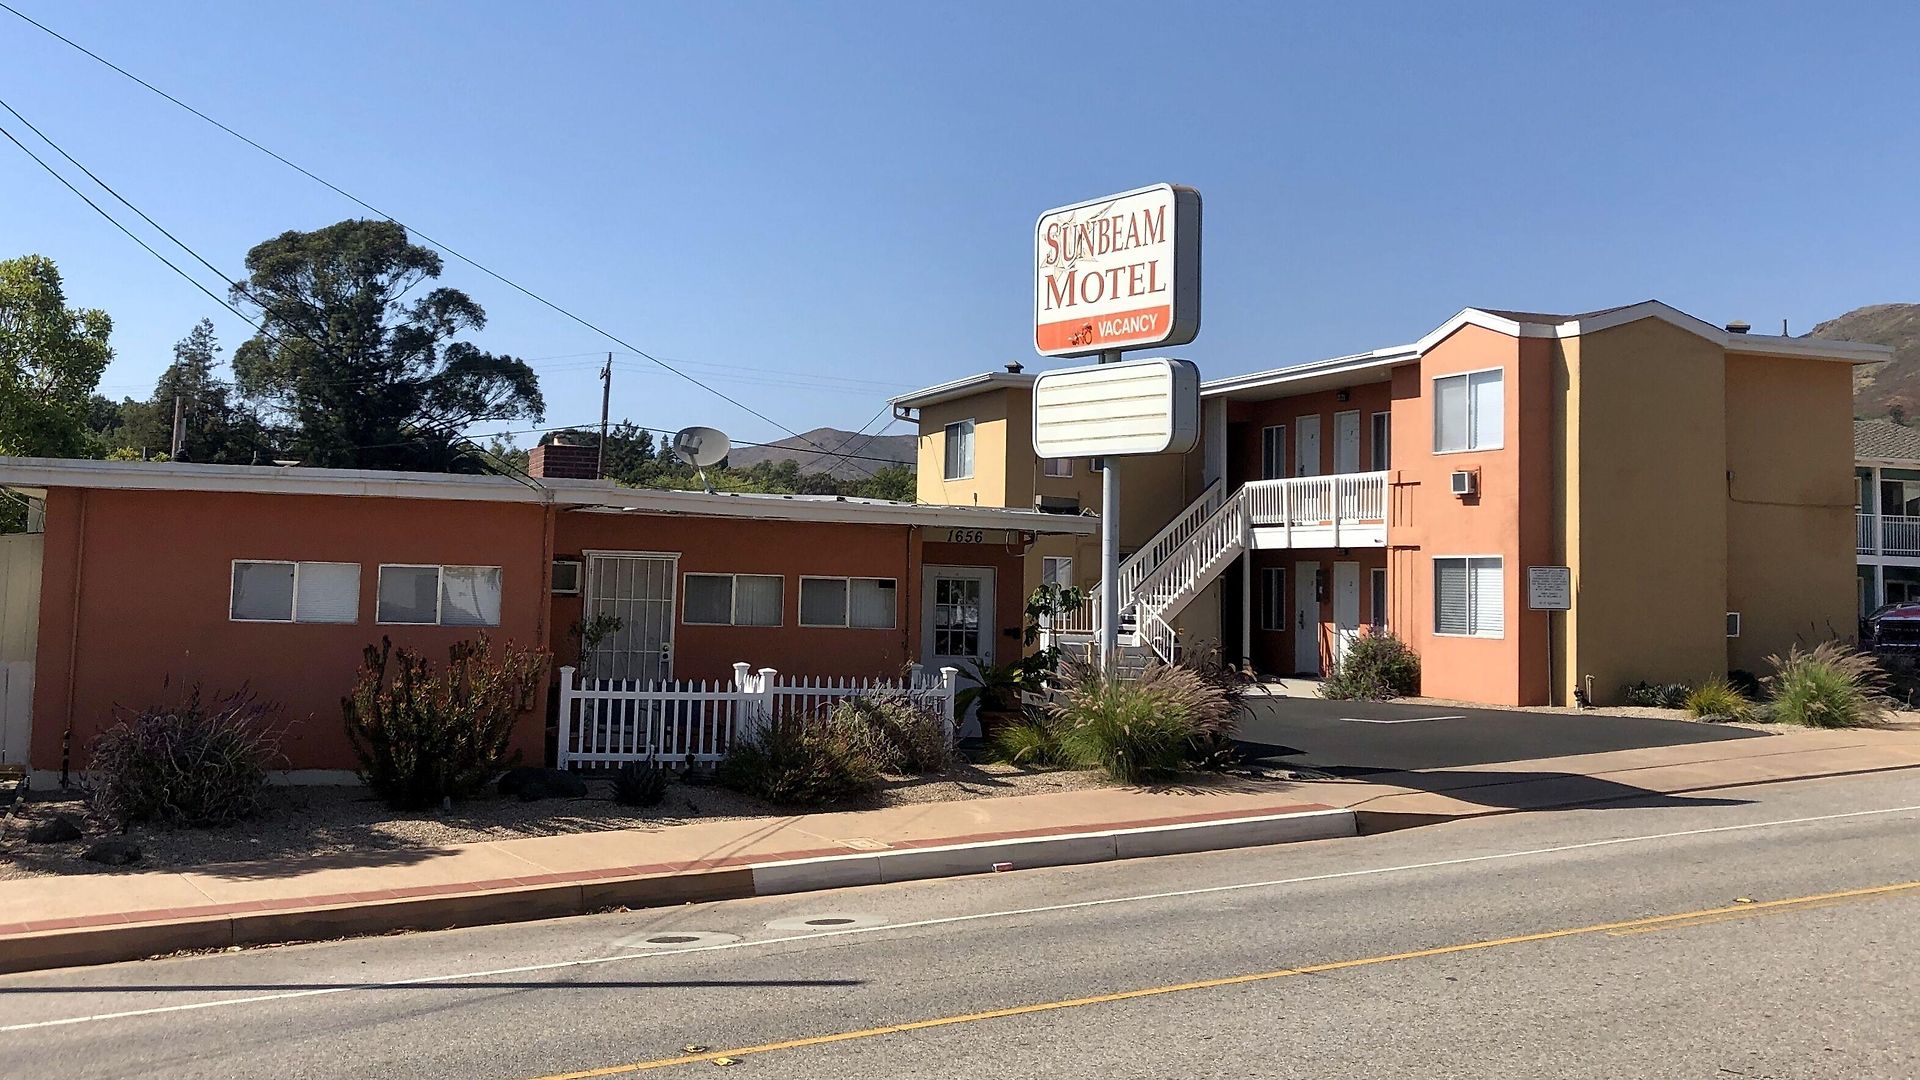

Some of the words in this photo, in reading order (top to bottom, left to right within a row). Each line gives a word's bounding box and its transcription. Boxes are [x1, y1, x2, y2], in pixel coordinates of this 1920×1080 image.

[1046, 205, 1166, 265] SUNBEAM
[1044, 260, 1166, 311] MOTEL
[1098, 313, 1158, 338] VACANCY
[947, 529, 983, 543] 1656
